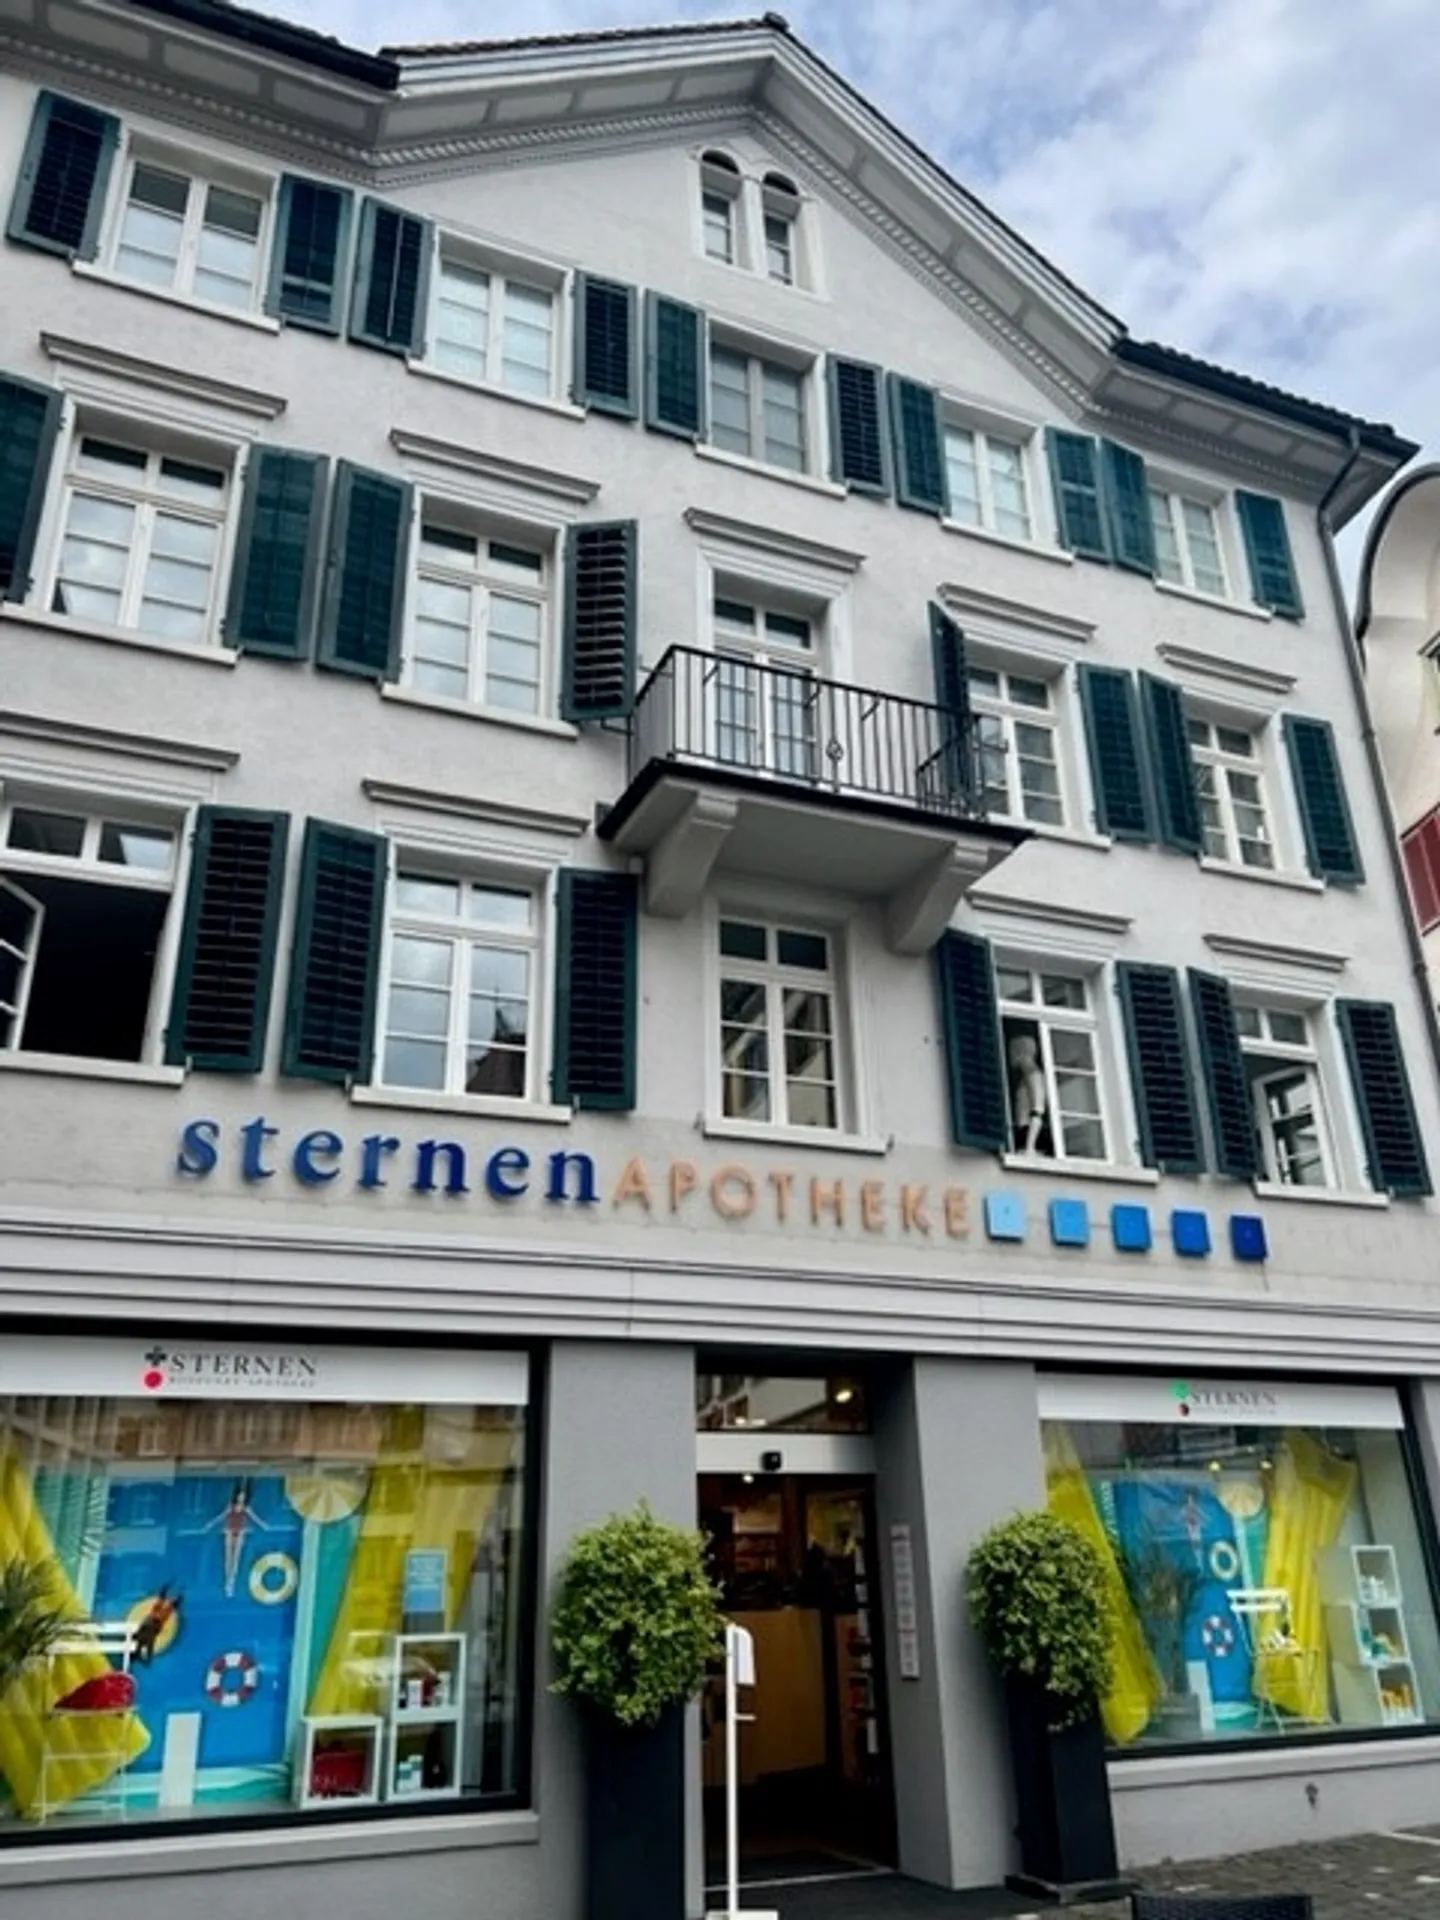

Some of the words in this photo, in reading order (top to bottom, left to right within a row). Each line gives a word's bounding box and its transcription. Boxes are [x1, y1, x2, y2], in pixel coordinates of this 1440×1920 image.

[177, 1115, 600, 1203] sternen
[612, 1155, 971, 1239] APOTHEKE
[168, 1352, 317, 1376] STERNEN
